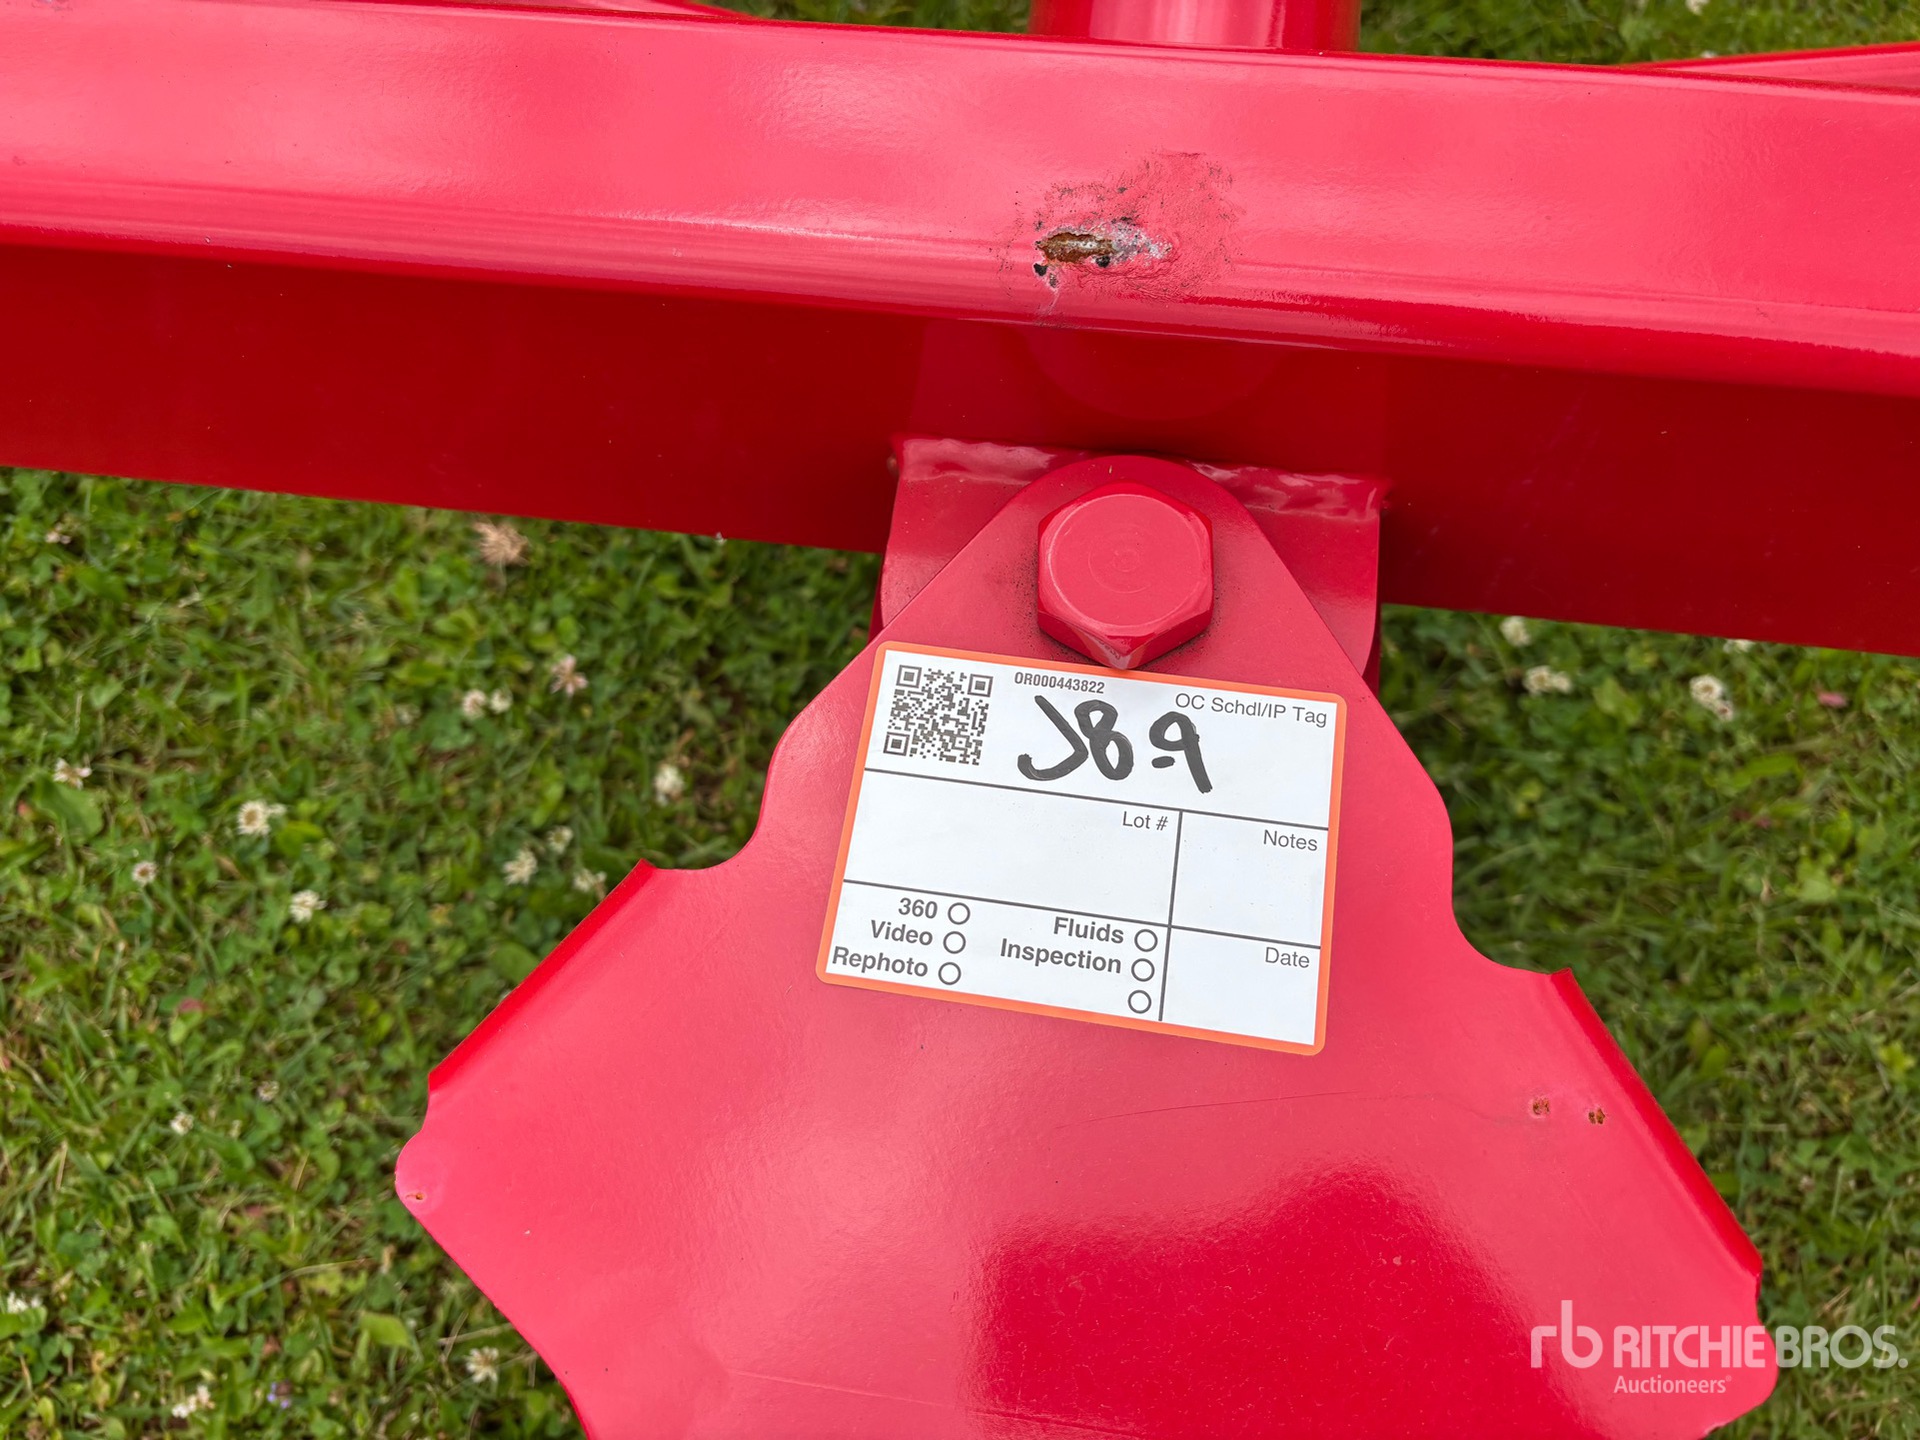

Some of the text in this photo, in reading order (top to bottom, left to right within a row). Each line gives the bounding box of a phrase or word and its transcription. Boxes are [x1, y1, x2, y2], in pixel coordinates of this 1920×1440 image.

[1175, 693, 1327, 728] OC Schdl/IP Tag
[1122, 810, 1169, 831] Lot #
[1263, 830, 1318, 852] Notes
[898, 898, 938, 920] 360
[870, 919, 933, 947] Video
[1053, 916, 1125, 945] Fluids
[831, 945, 929, 977] Rephoto
[1000, 937, 1122, 975] Inspection
[1264, 947, 1311, 969] Date
